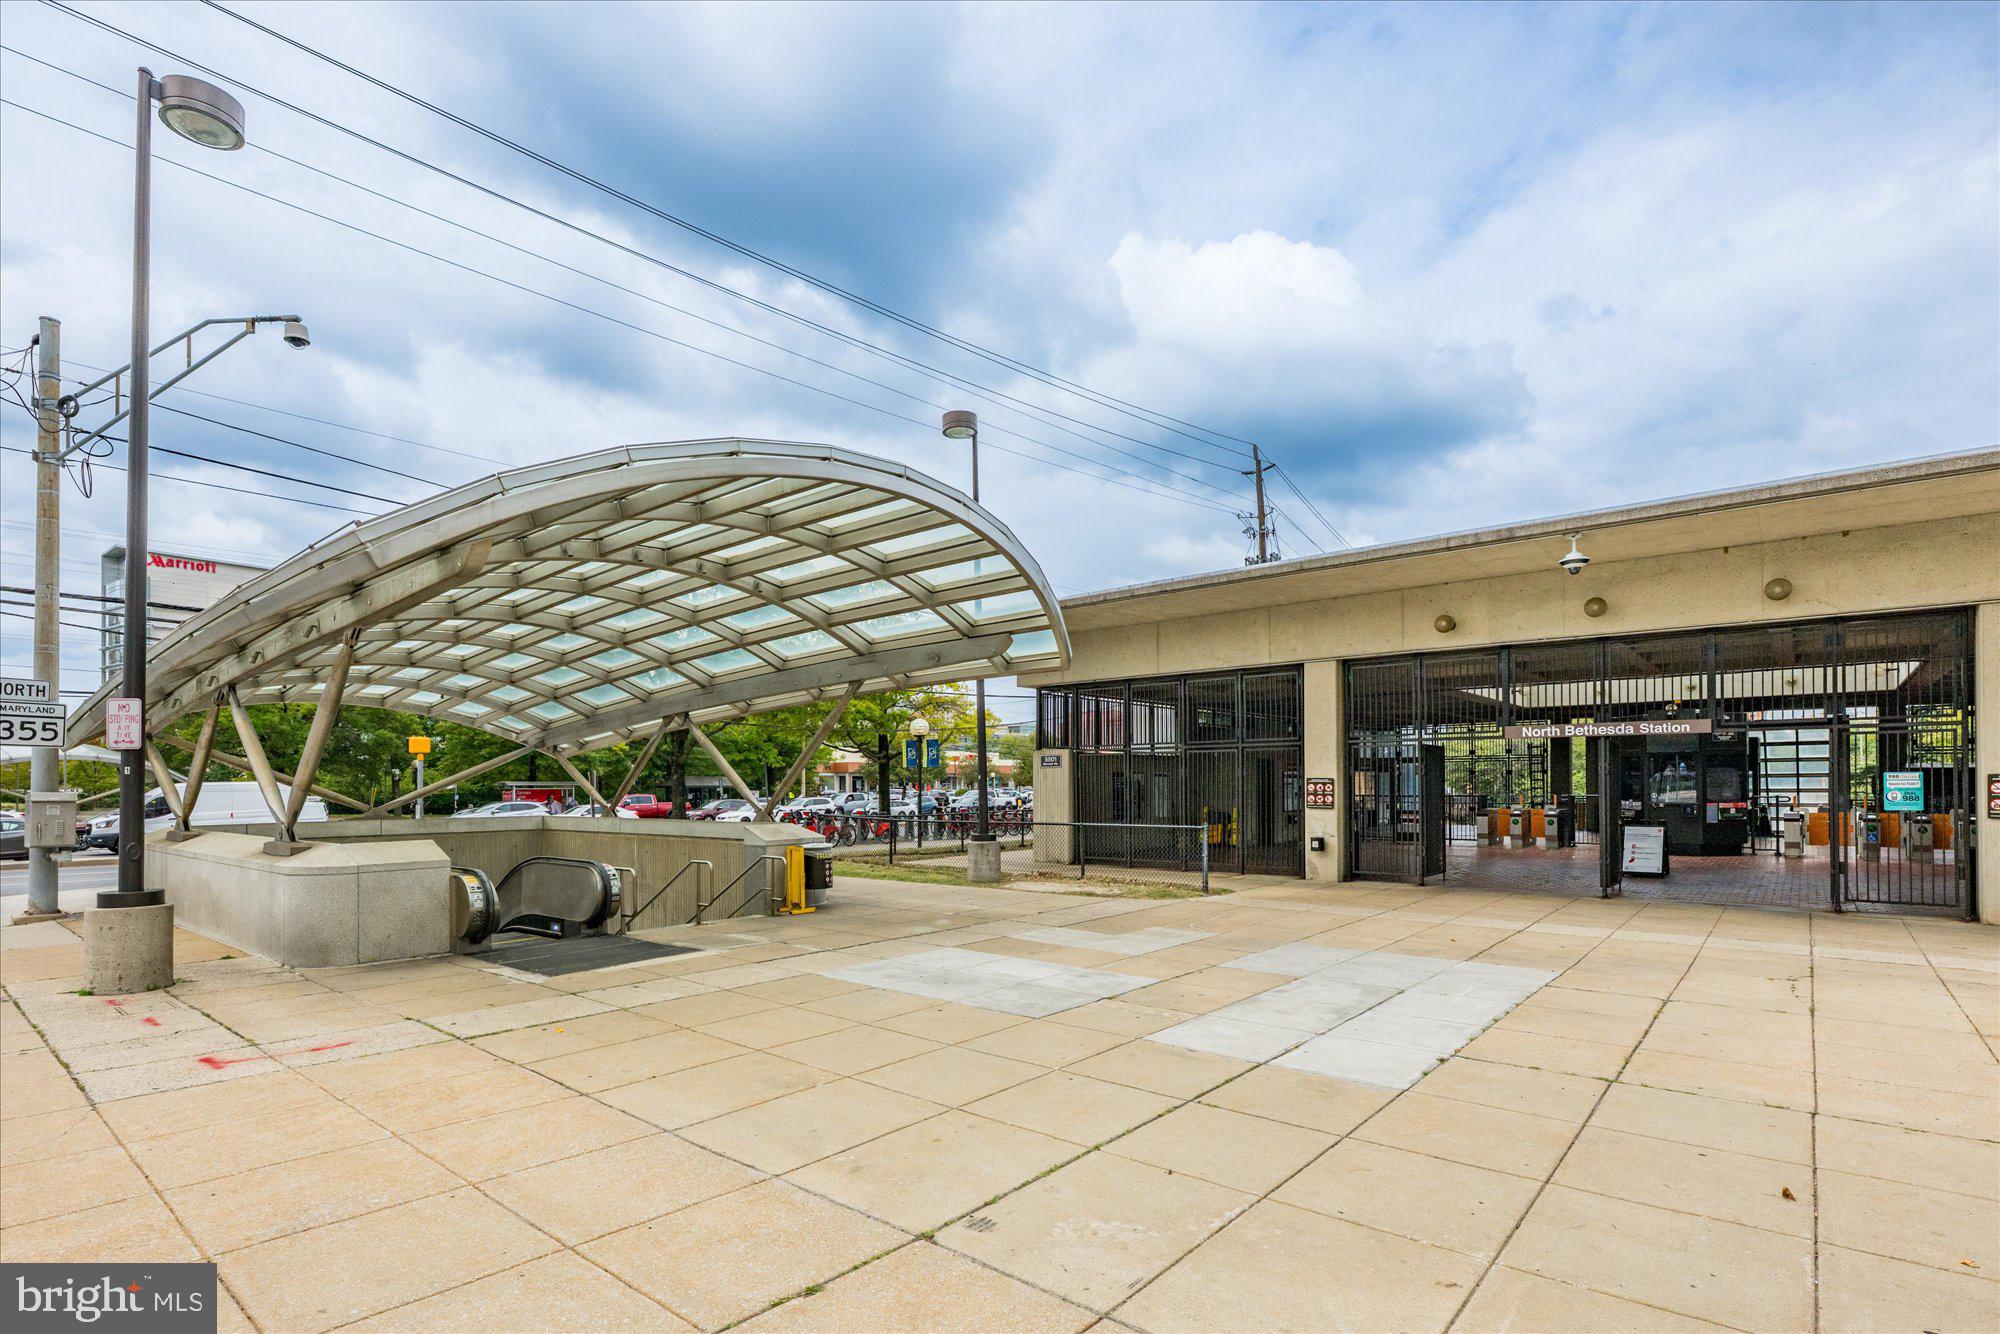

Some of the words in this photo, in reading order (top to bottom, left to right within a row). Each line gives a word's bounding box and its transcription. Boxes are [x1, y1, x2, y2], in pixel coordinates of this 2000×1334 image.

[147, 553, 217, 574] Marriott
[0, 682, 46, 697] ORTH
[0, 704, 56, 714] MARYLAND
[117, 703, 131, 713] NO
[0, 719, 59, 741] 355
[1522, 726, 1561, 737] North
[1565, 723, 1634, 736] Bethesda
[1639, 722, 1690, 734] Station
